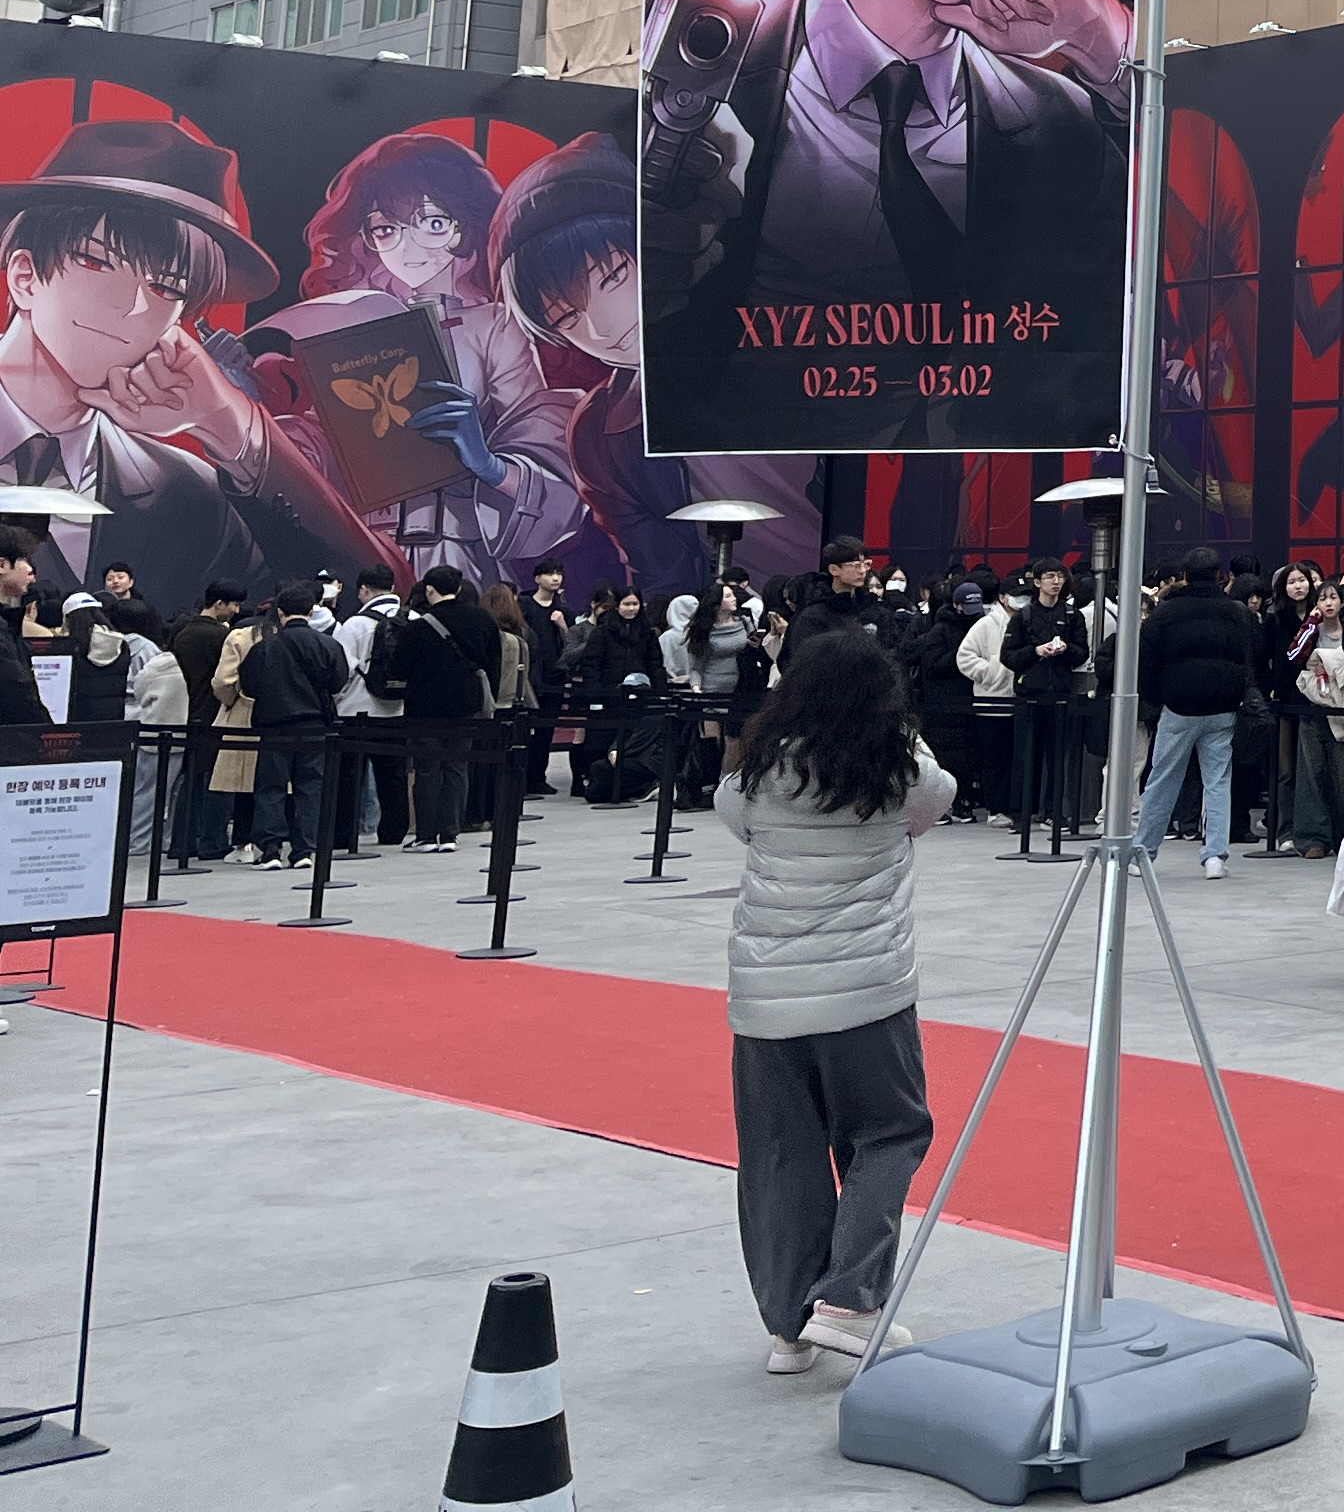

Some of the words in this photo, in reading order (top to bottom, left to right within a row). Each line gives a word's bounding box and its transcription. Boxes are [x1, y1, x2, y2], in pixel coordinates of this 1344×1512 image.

[736, 304, 817, 348] XYZ
[826, 302, 954, 346] SEOUL
[962, 299, 996, 345] in
[1003, 300, 1060, 342] 성수
[331, 353, 378, 373] Butterfly
[380, 348, 408, 360] Corp.
[803, 366, 877, 398] 02.25
[918, 364, 992, 397] 03.02
